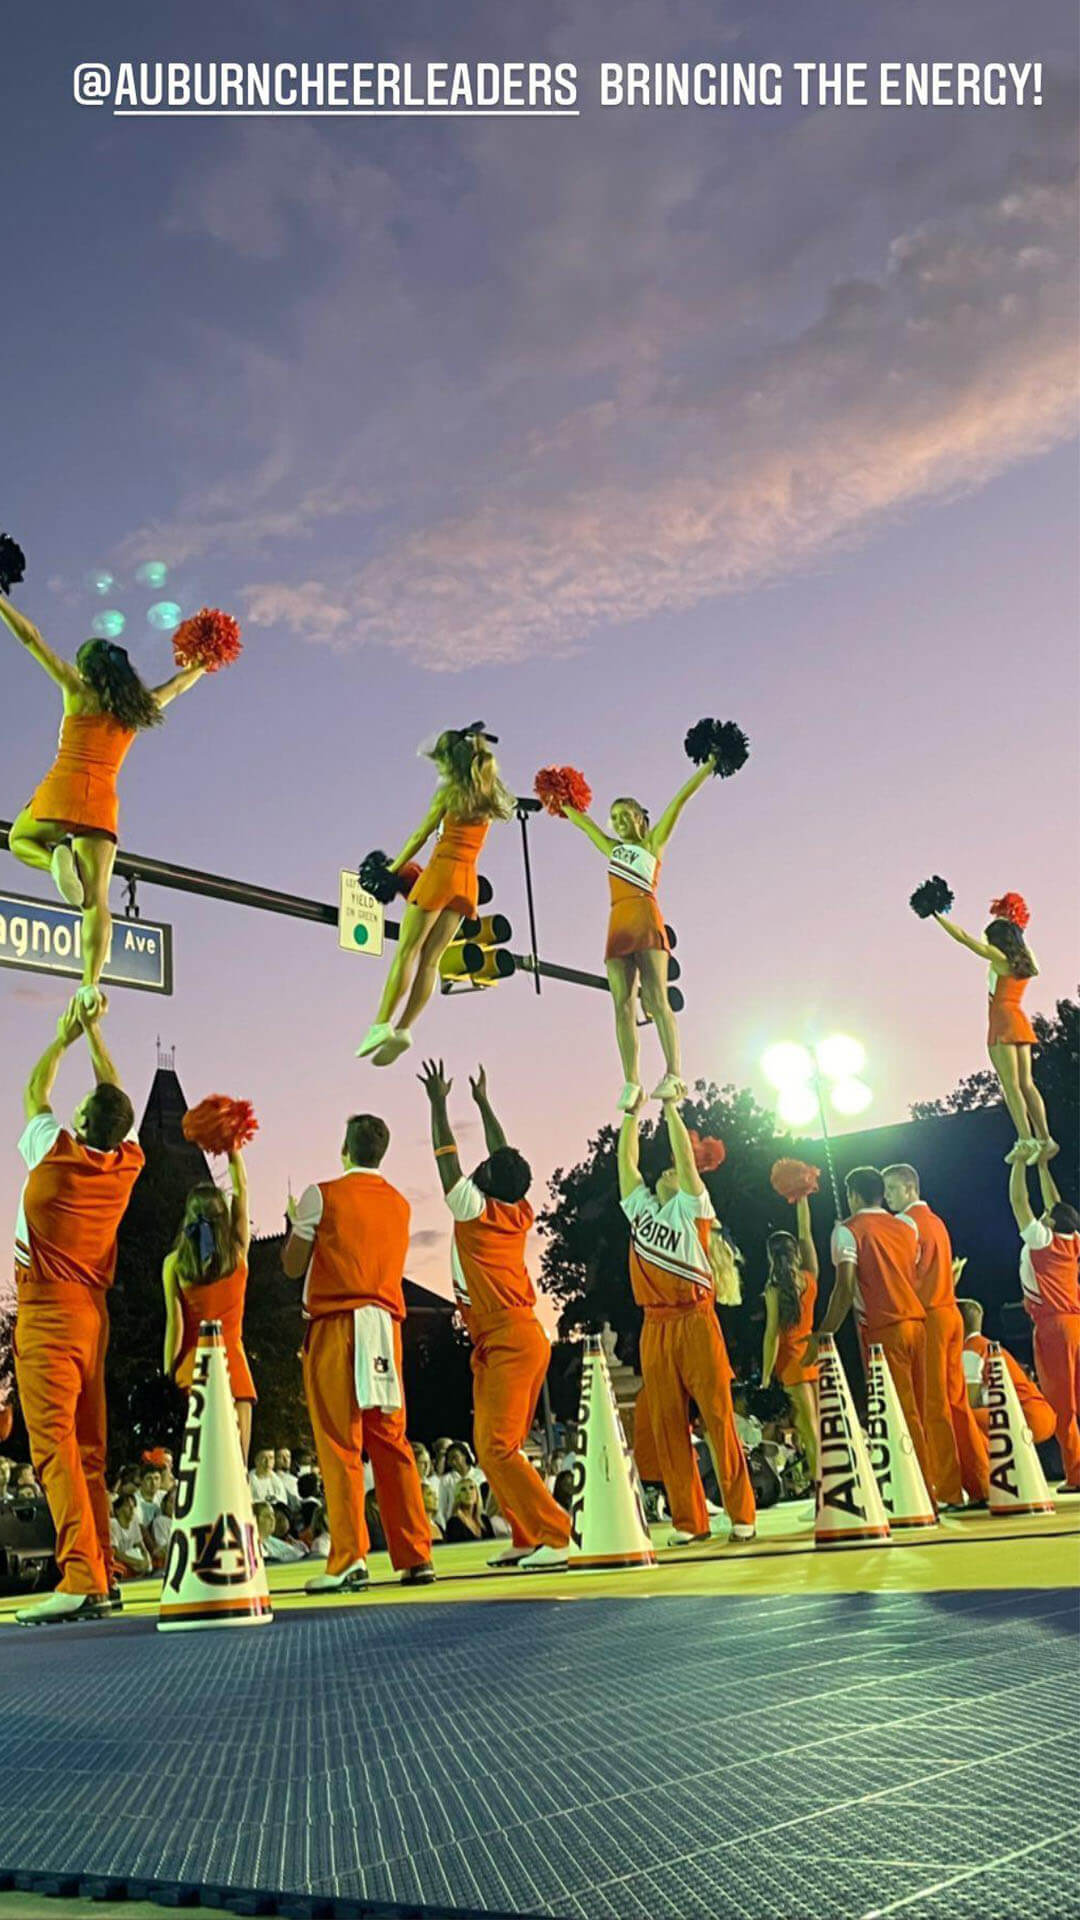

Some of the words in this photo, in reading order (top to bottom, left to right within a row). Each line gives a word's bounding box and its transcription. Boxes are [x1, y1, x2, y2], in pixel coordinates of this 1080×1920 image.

[0, 914, 111, 963] gnol
[124, 930, 156, 954] Ave
[351, 893, 375, 909] YIELD
[817, 1356, 867, 1521] AUBURN
[988, 1359, 1020, 1498] AUBURN
